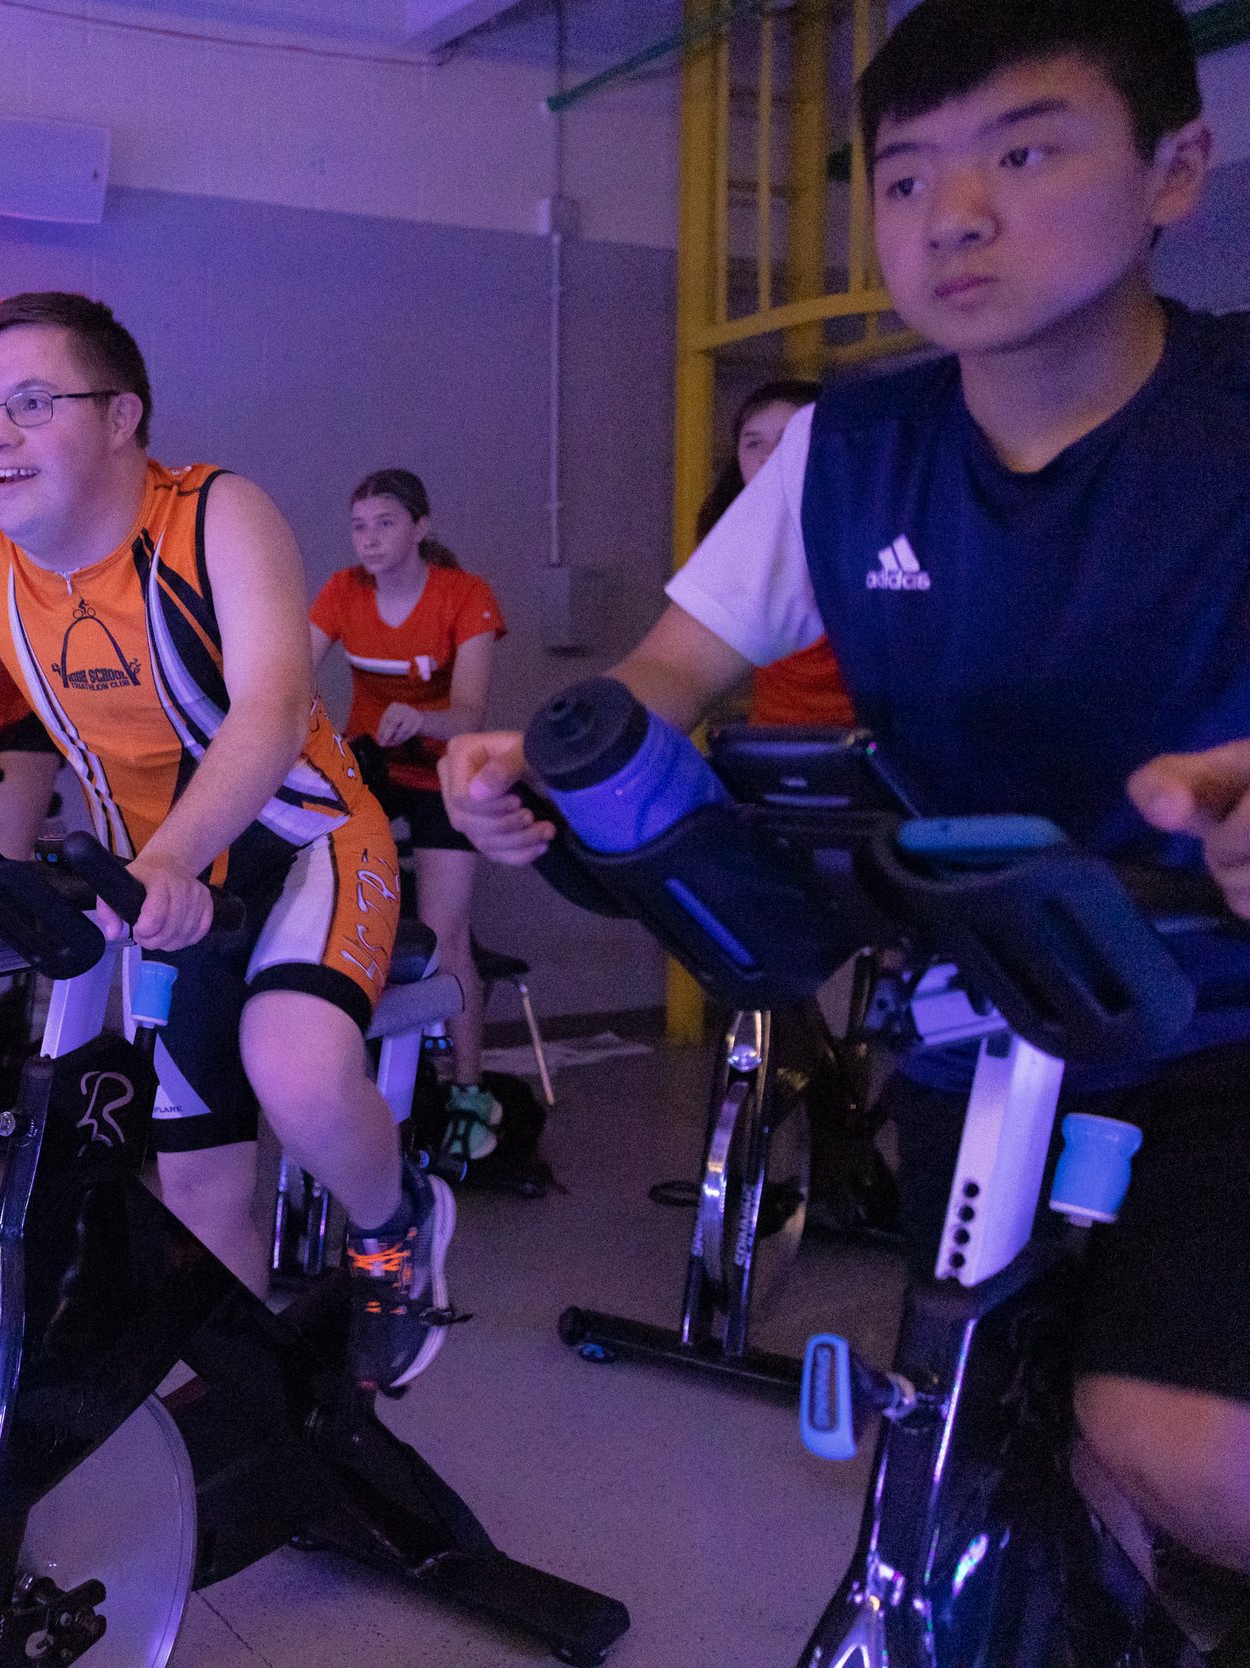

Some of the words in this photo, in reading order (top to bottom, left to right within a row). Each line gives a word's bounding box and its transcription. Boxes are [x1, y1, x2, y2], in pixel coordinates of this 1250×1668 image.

[866, 568, 930, 590] adidas
[68, 670, 88, 684] HIGH
[88, 668, 127, 684] SCHOOL
[71, 680, 109, 691] TRIATHLON
[110, 679, 131, 689] CLUB
